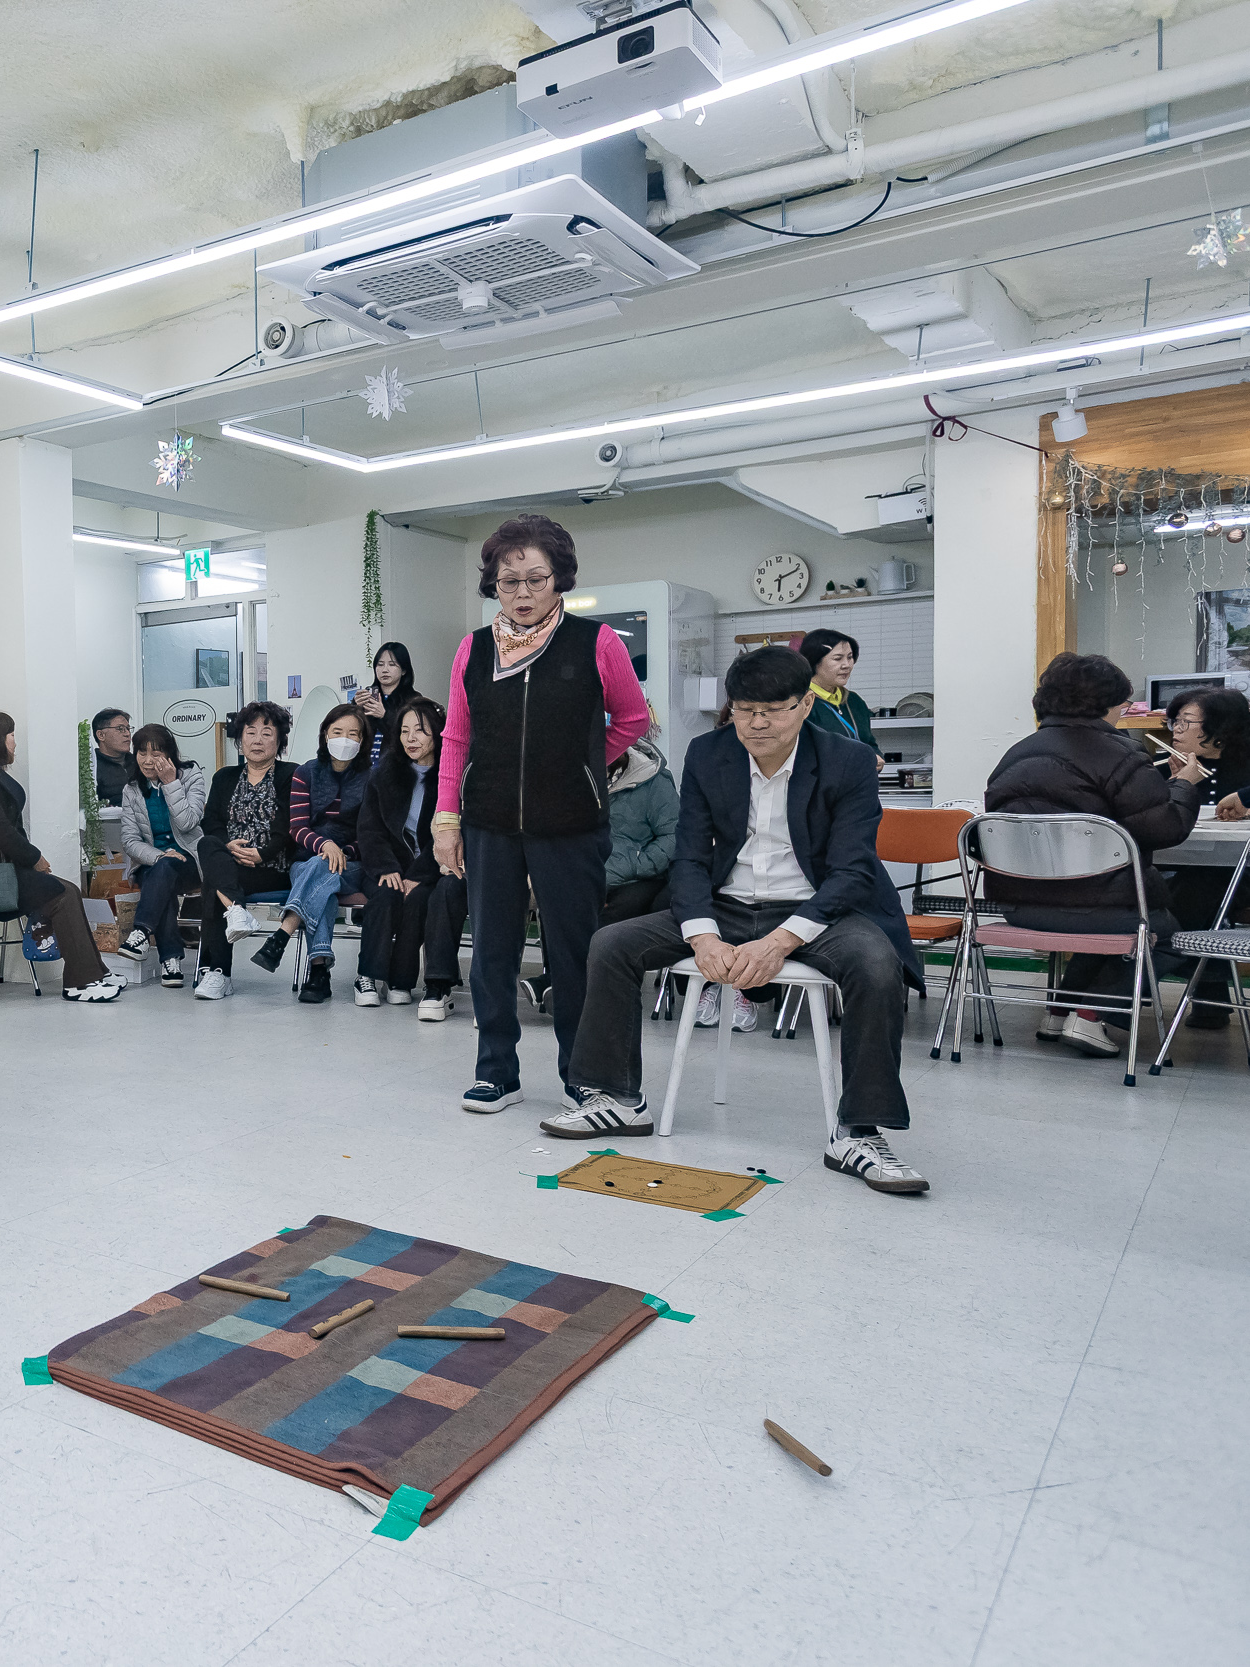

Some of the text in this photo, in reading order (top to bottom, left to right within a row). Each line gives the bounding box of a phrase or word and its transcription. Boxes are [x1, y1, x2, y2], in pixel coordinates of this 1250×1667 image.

[778, 594, 784, 602] 6
[789, 590, 795, 598] 5
[172, 714, 207, 723] ORDINARY
